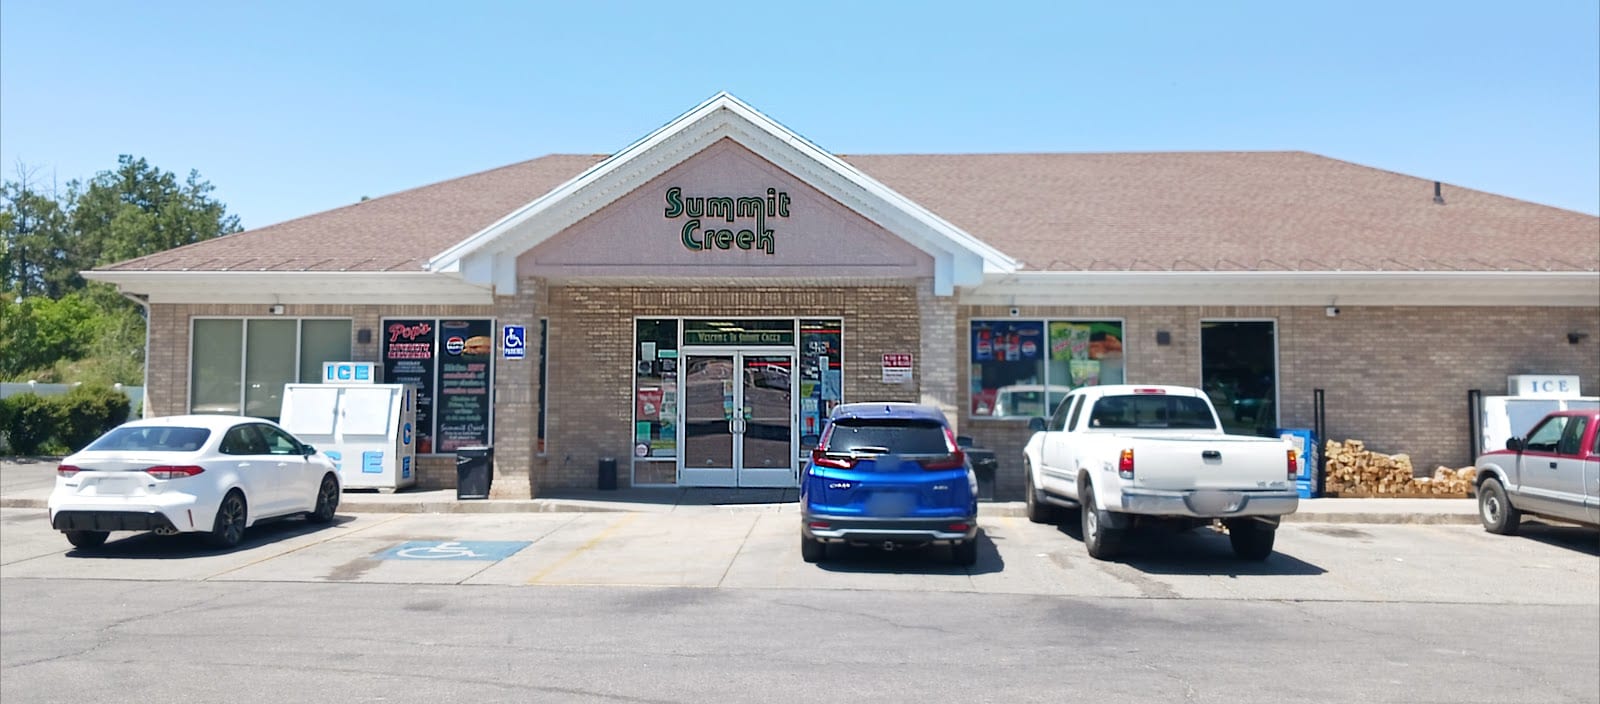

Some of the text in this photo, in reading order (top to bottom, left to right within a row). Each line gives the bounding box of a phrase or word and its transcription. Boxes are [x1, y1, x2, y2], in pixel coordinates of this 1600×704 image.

[665, 186, 791, 222] Summit
[681, 219, 775, 254] Creek
[389, 322, 431, 342] Pop's
[327, 365, 369, 380] ICE
[1532, 381, 1570, 392] ICE
[402, 389, 412, 479] ICE
